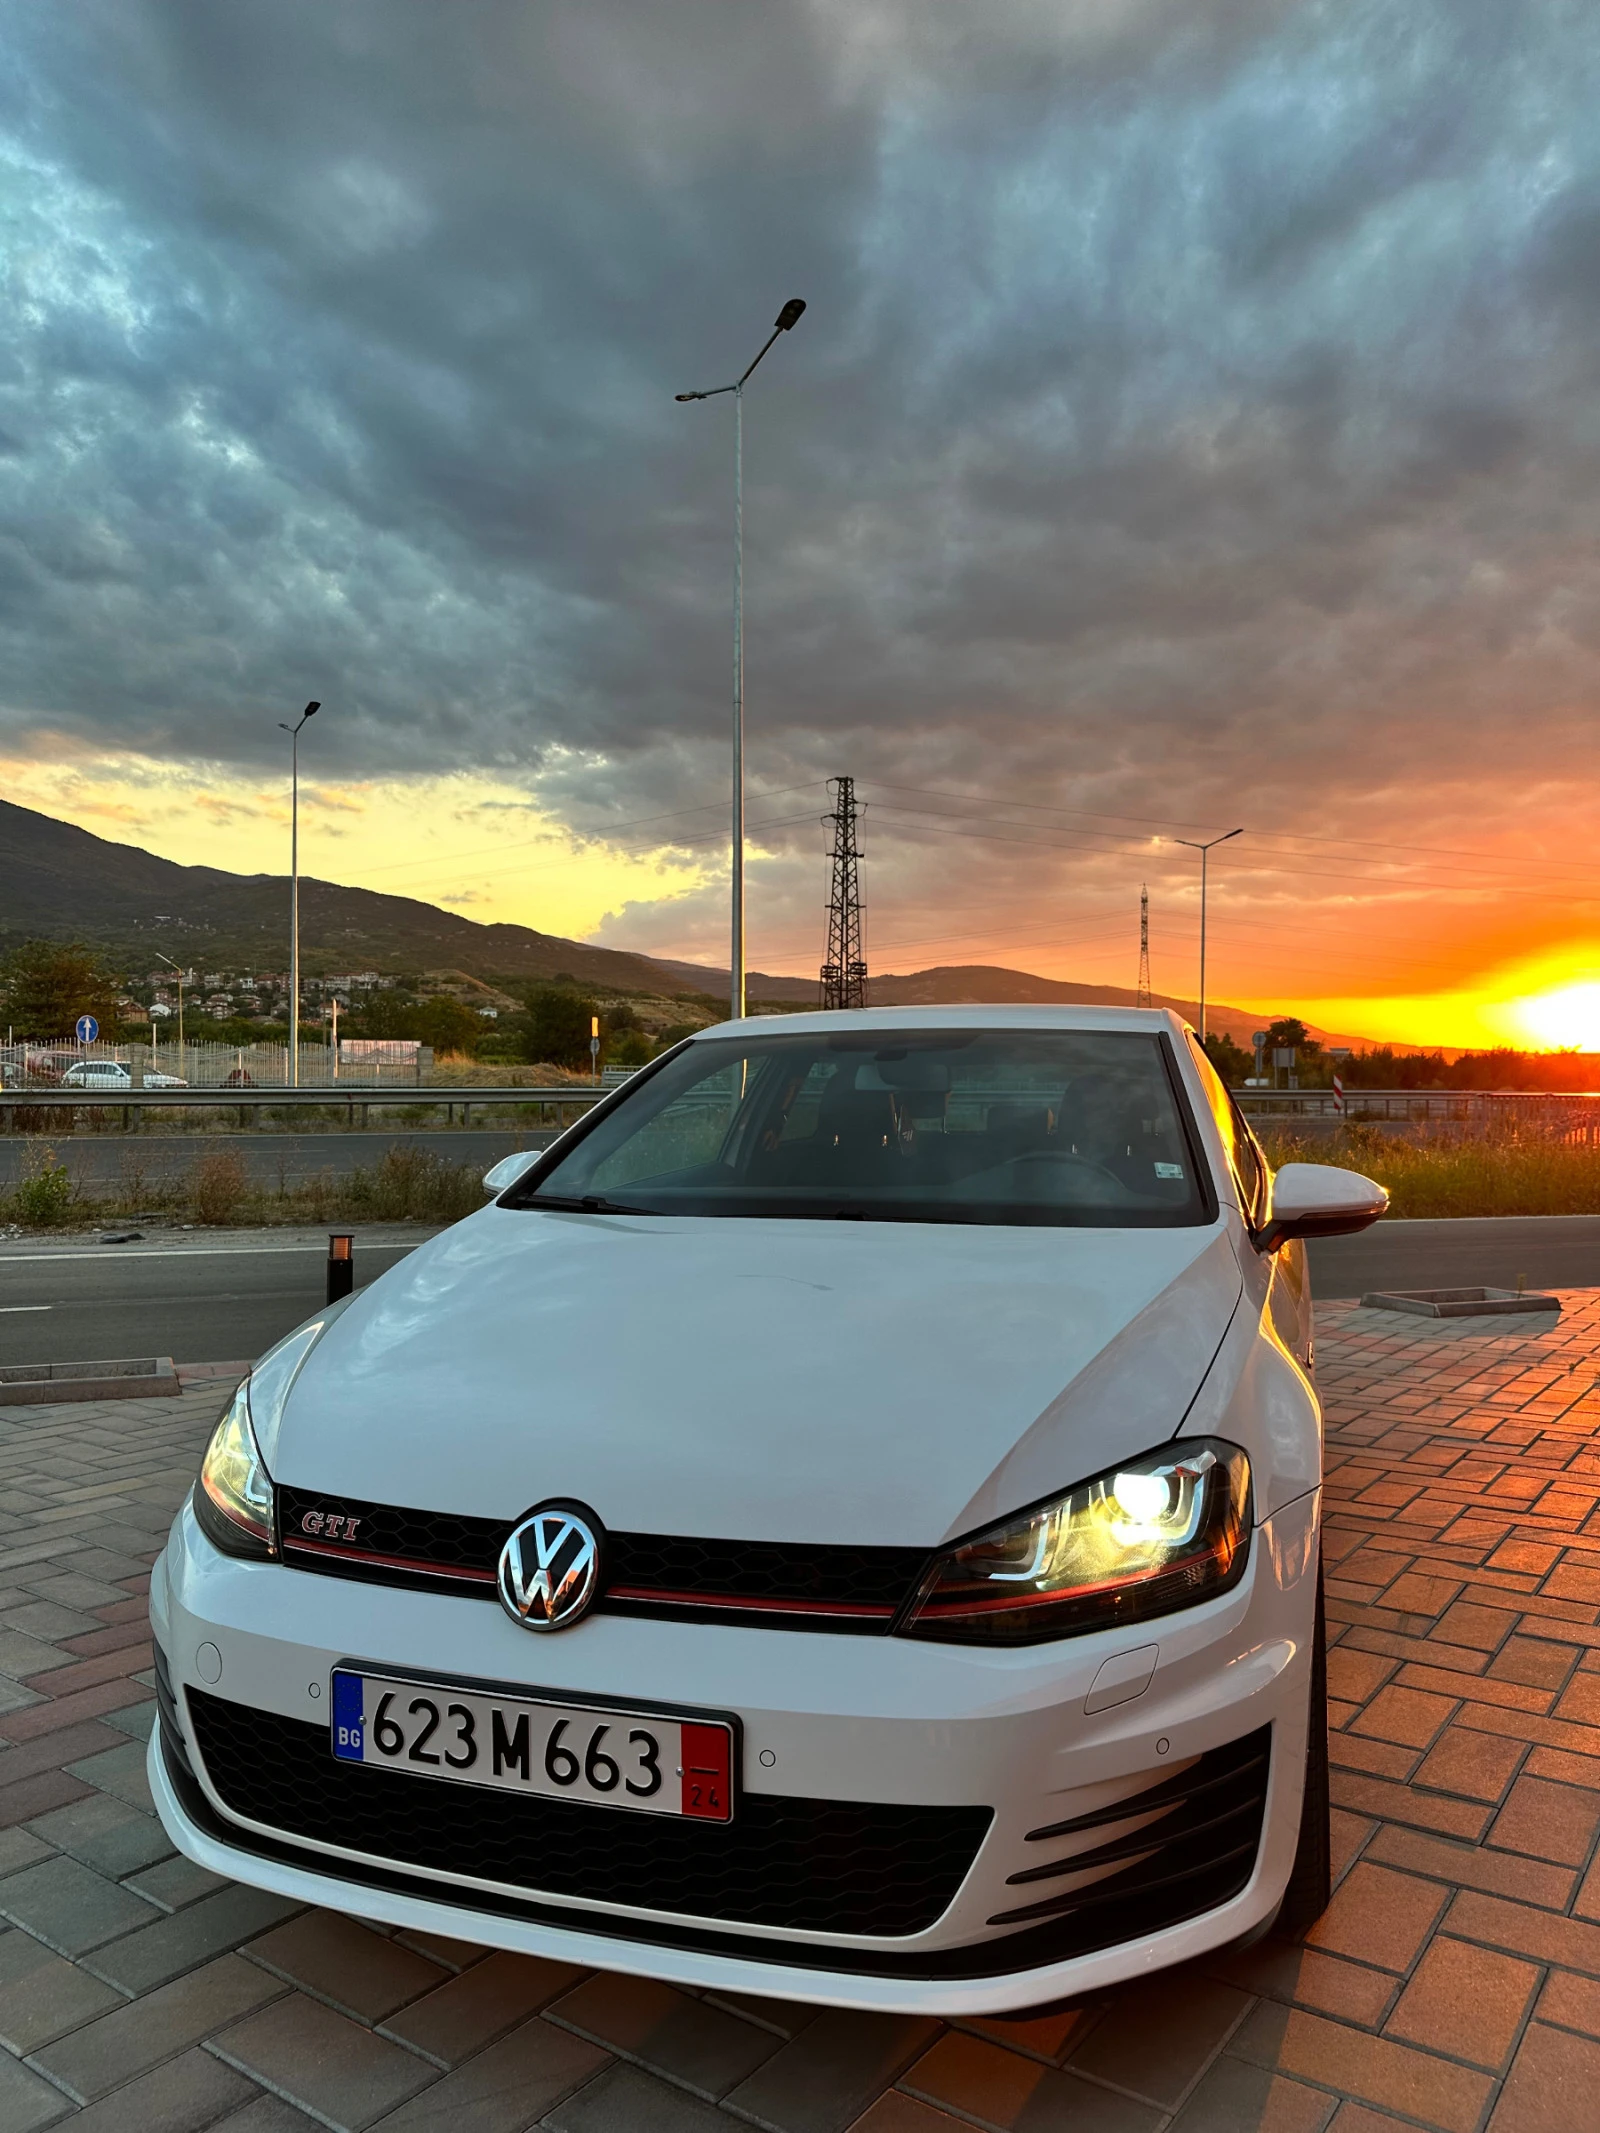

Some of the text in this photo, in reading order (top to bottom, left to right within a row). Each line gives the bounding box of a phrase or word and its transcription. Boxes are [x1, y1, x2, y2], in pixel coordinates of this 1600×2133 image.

[302, 1511, 361, 1541] GTI
[499, 1511, 598, 1625] VW
[338, 1726, 361, 1748] BG
[373, 1691, 662, 1798] 623 M 663
[690, 1784, 720, 1808] 24
